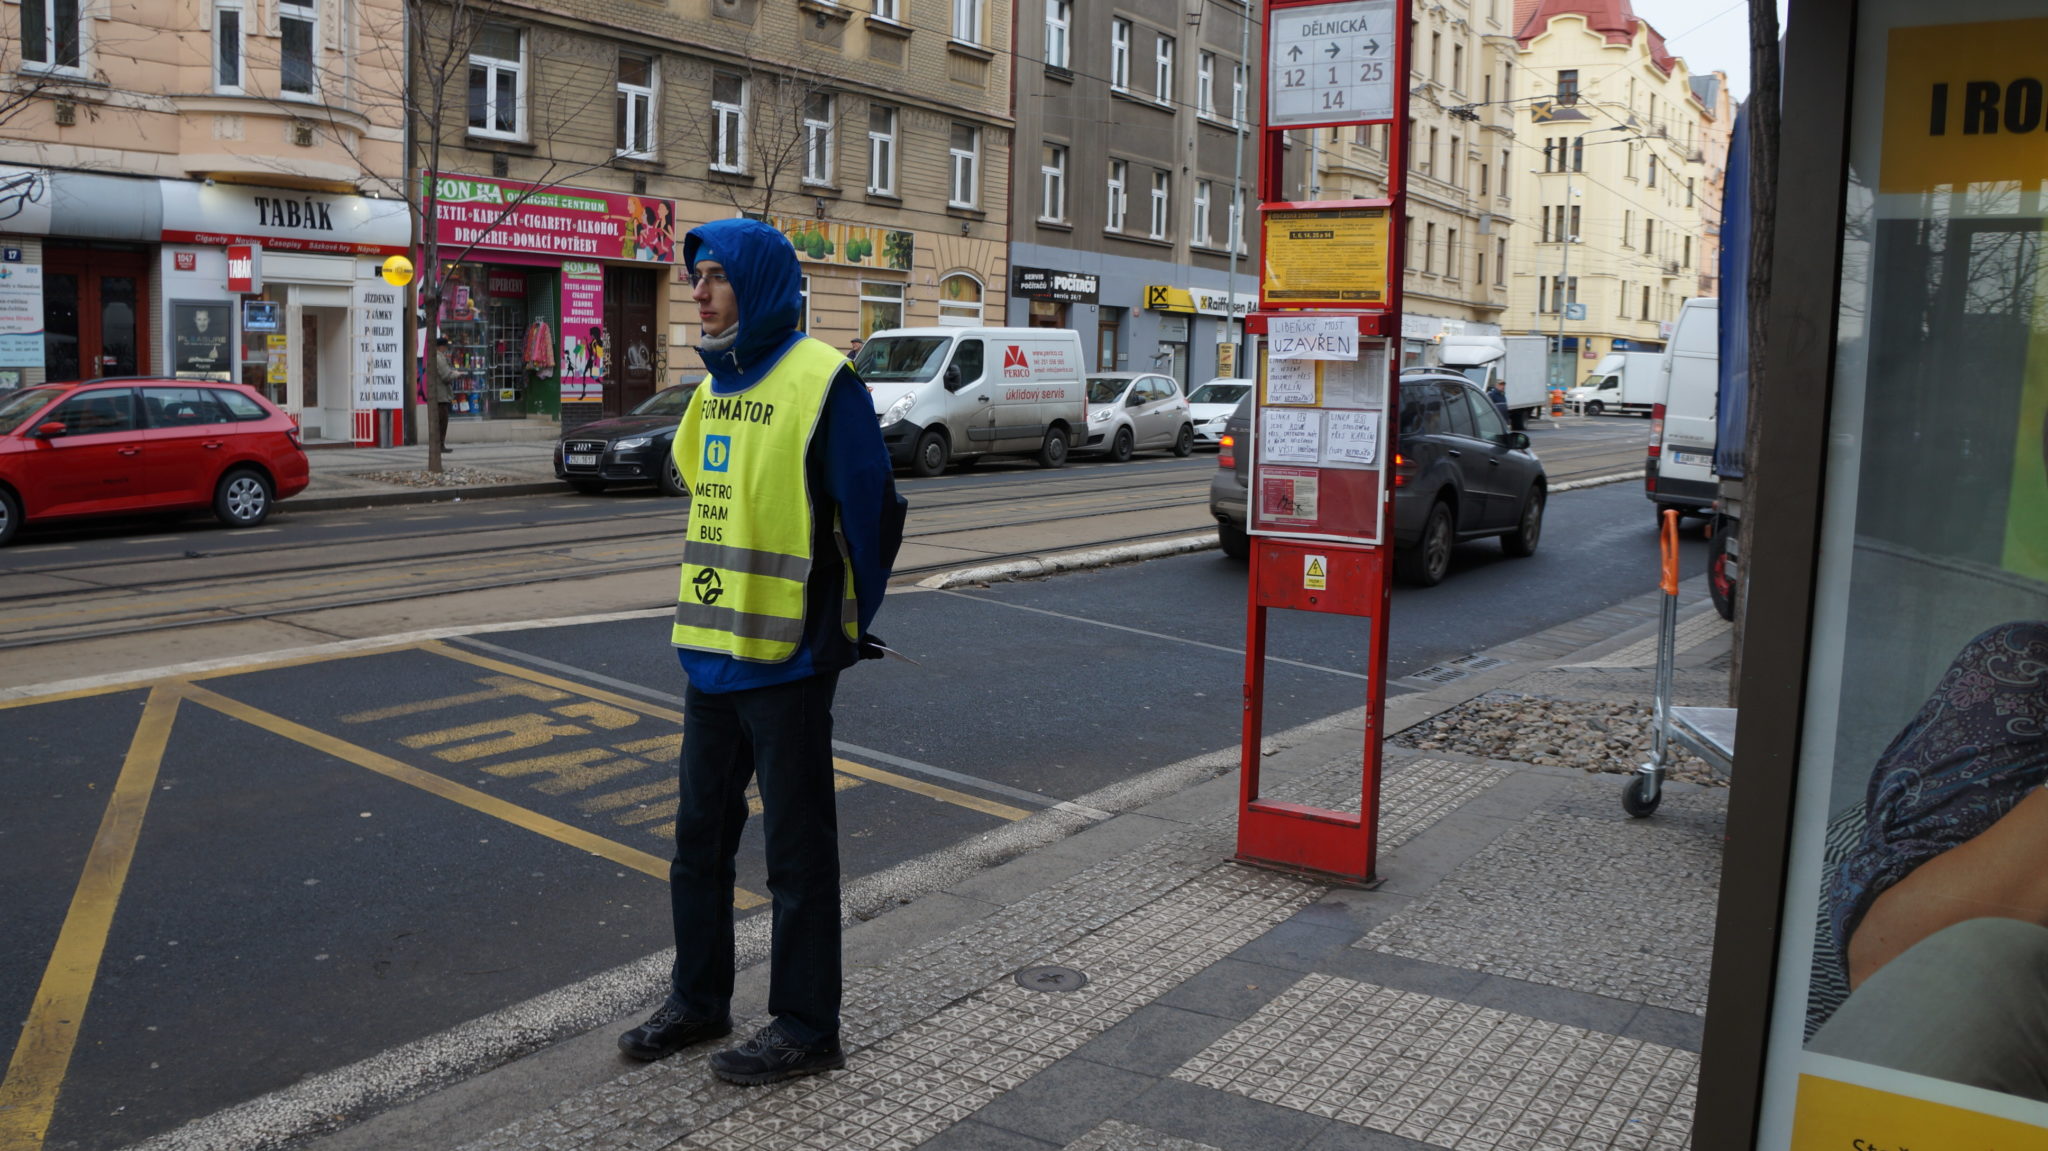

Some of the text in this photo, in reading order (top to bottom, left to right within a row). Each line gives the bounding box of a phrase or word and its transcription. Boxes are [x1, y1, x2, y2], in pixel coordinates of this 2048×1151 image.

[1302, 16, 1368, 37] DĚLNICKÁ
[1284, 62, 1383, 88] 12 1 25
[1322, 91, 1344, 109] 14
[1929, 77, 2048, 136] I RO
[436, 180, 471, 199] SON
[254, 196, 333, 231] TABÁK
[561, 199, 605, 213] CENTRUM
[436, 204, 467, 221] EXTIL
[524, 213, 572, 232] CIGARETY
[577, 219, 618, 236] ALKOHOL
[195, 233, 228, 245] Cigarety
[268, 238, 302, 250] Časopisy
[309, 242, 338, 252] Sázkové
[339, 244, 350, 253] hry
[357, 244, 381, 255] Nápoje
[454, 227, 597, 253] DROGERIE DOMÁCÍ POTŘEBY
[8, 250, 17, 260] 17
[177, 254, 193, 263] 1047
[228, 256, 252, 279] TABÁK
[564, 262, 583, 272] SON
[1021, 281, 1047, 290] POČÍTAČŮ
[1054, 274, 1096, 294] POČÍTAČŮ
[364, 293, 395, 304] JÍZDENKY
[1275, 319, 1345, 333] LIBEŇSKÝ MOST
[377, 343, 398, 353] KARTY
[1274, 333, 1351, 354] UZAVŘEN
[1004, 369, 1030, 378] PERICO
[360, 390, 399, 401] ZAALOVAČE
[1006, 387, 1065, 402] úklidový servis
[701, 395, 774, 425] FORMÁTOR
[1270, 413, 1290, 421] LINKA
[695, 482, 732, 500] METRO
[697, 503, 729, 521] TRAM
[700, 525, 723, 542] BUS
